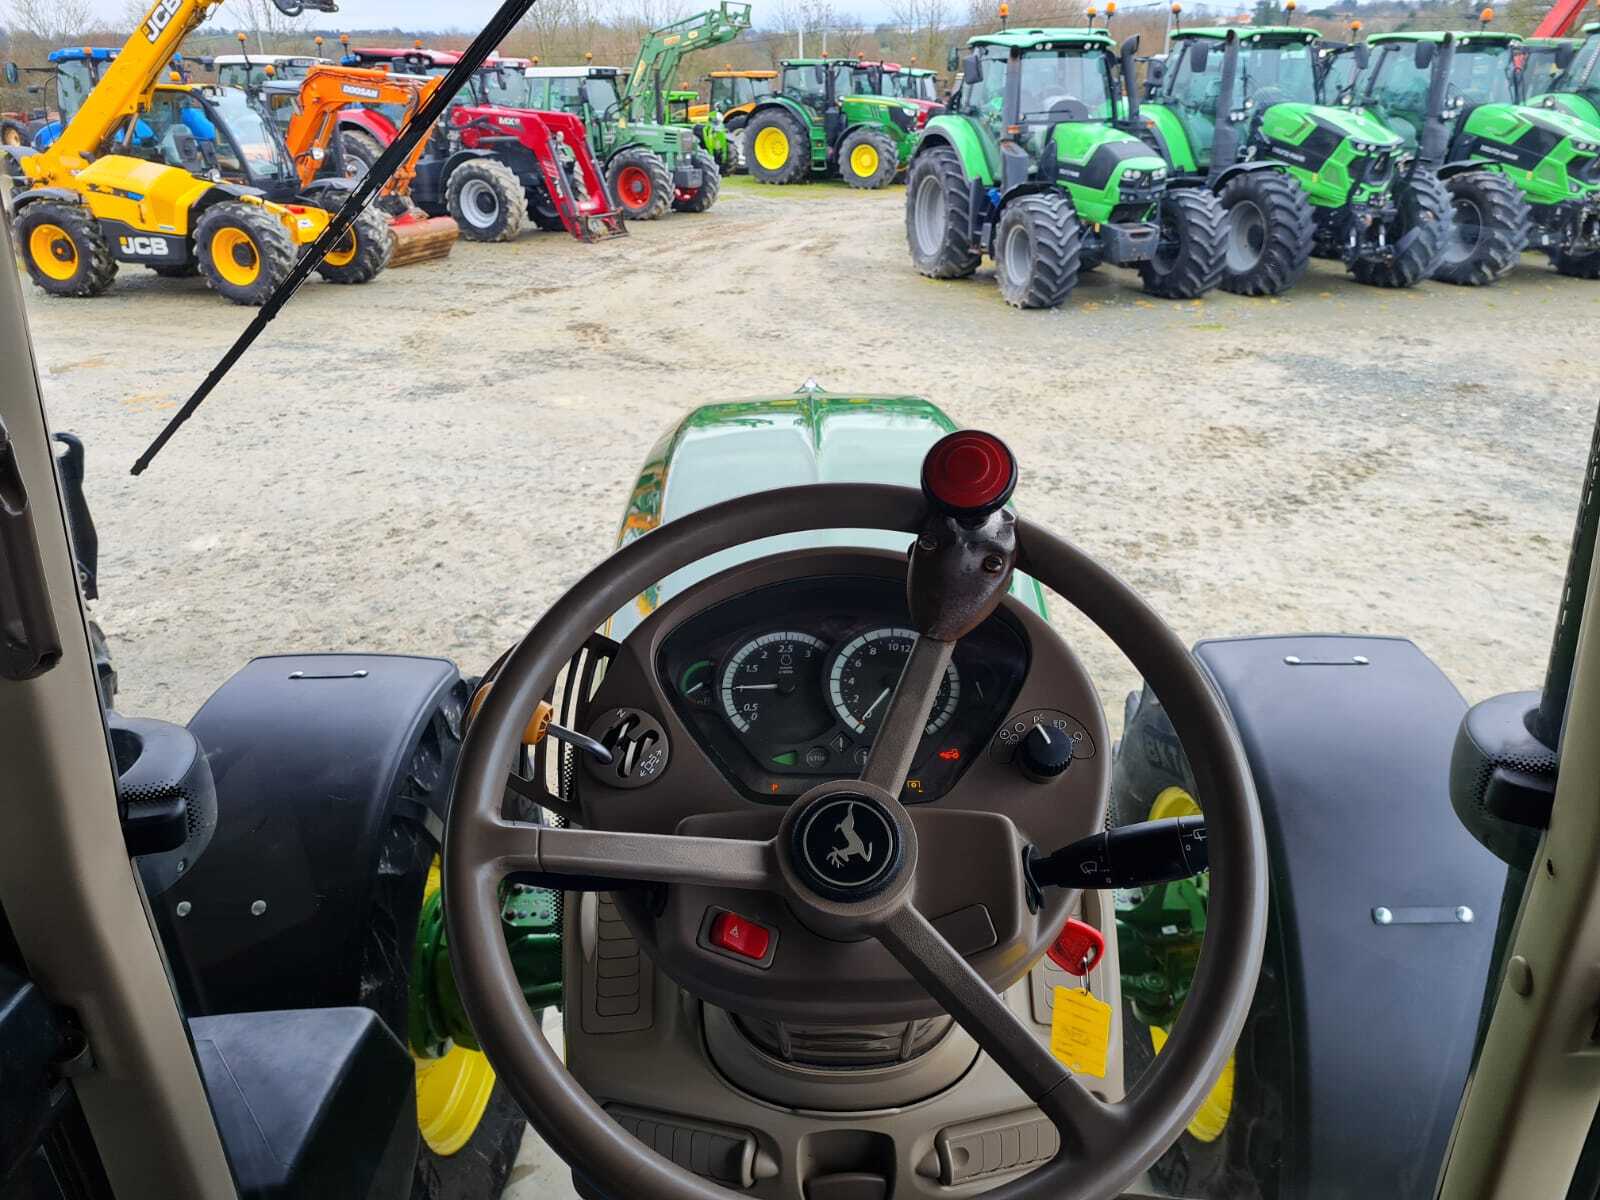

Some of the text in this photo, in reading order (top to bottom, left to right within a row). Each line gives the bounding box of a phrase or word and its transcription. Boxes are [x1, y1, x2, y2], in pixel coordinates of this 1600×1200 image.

[144, 0, 182, 43] JCB
[119, 236, 169, 256] JCB
[778, 645, 793, 653] 2.5
[869, 647, 877, 656] 8
[888, 643, 899, 651] 10
[901, 644, 911, 653] 12
[760, 651, 768, 659] 2
[745, 664, 759, 673] 1.5
[743, 703, 758, 712] 0.5
